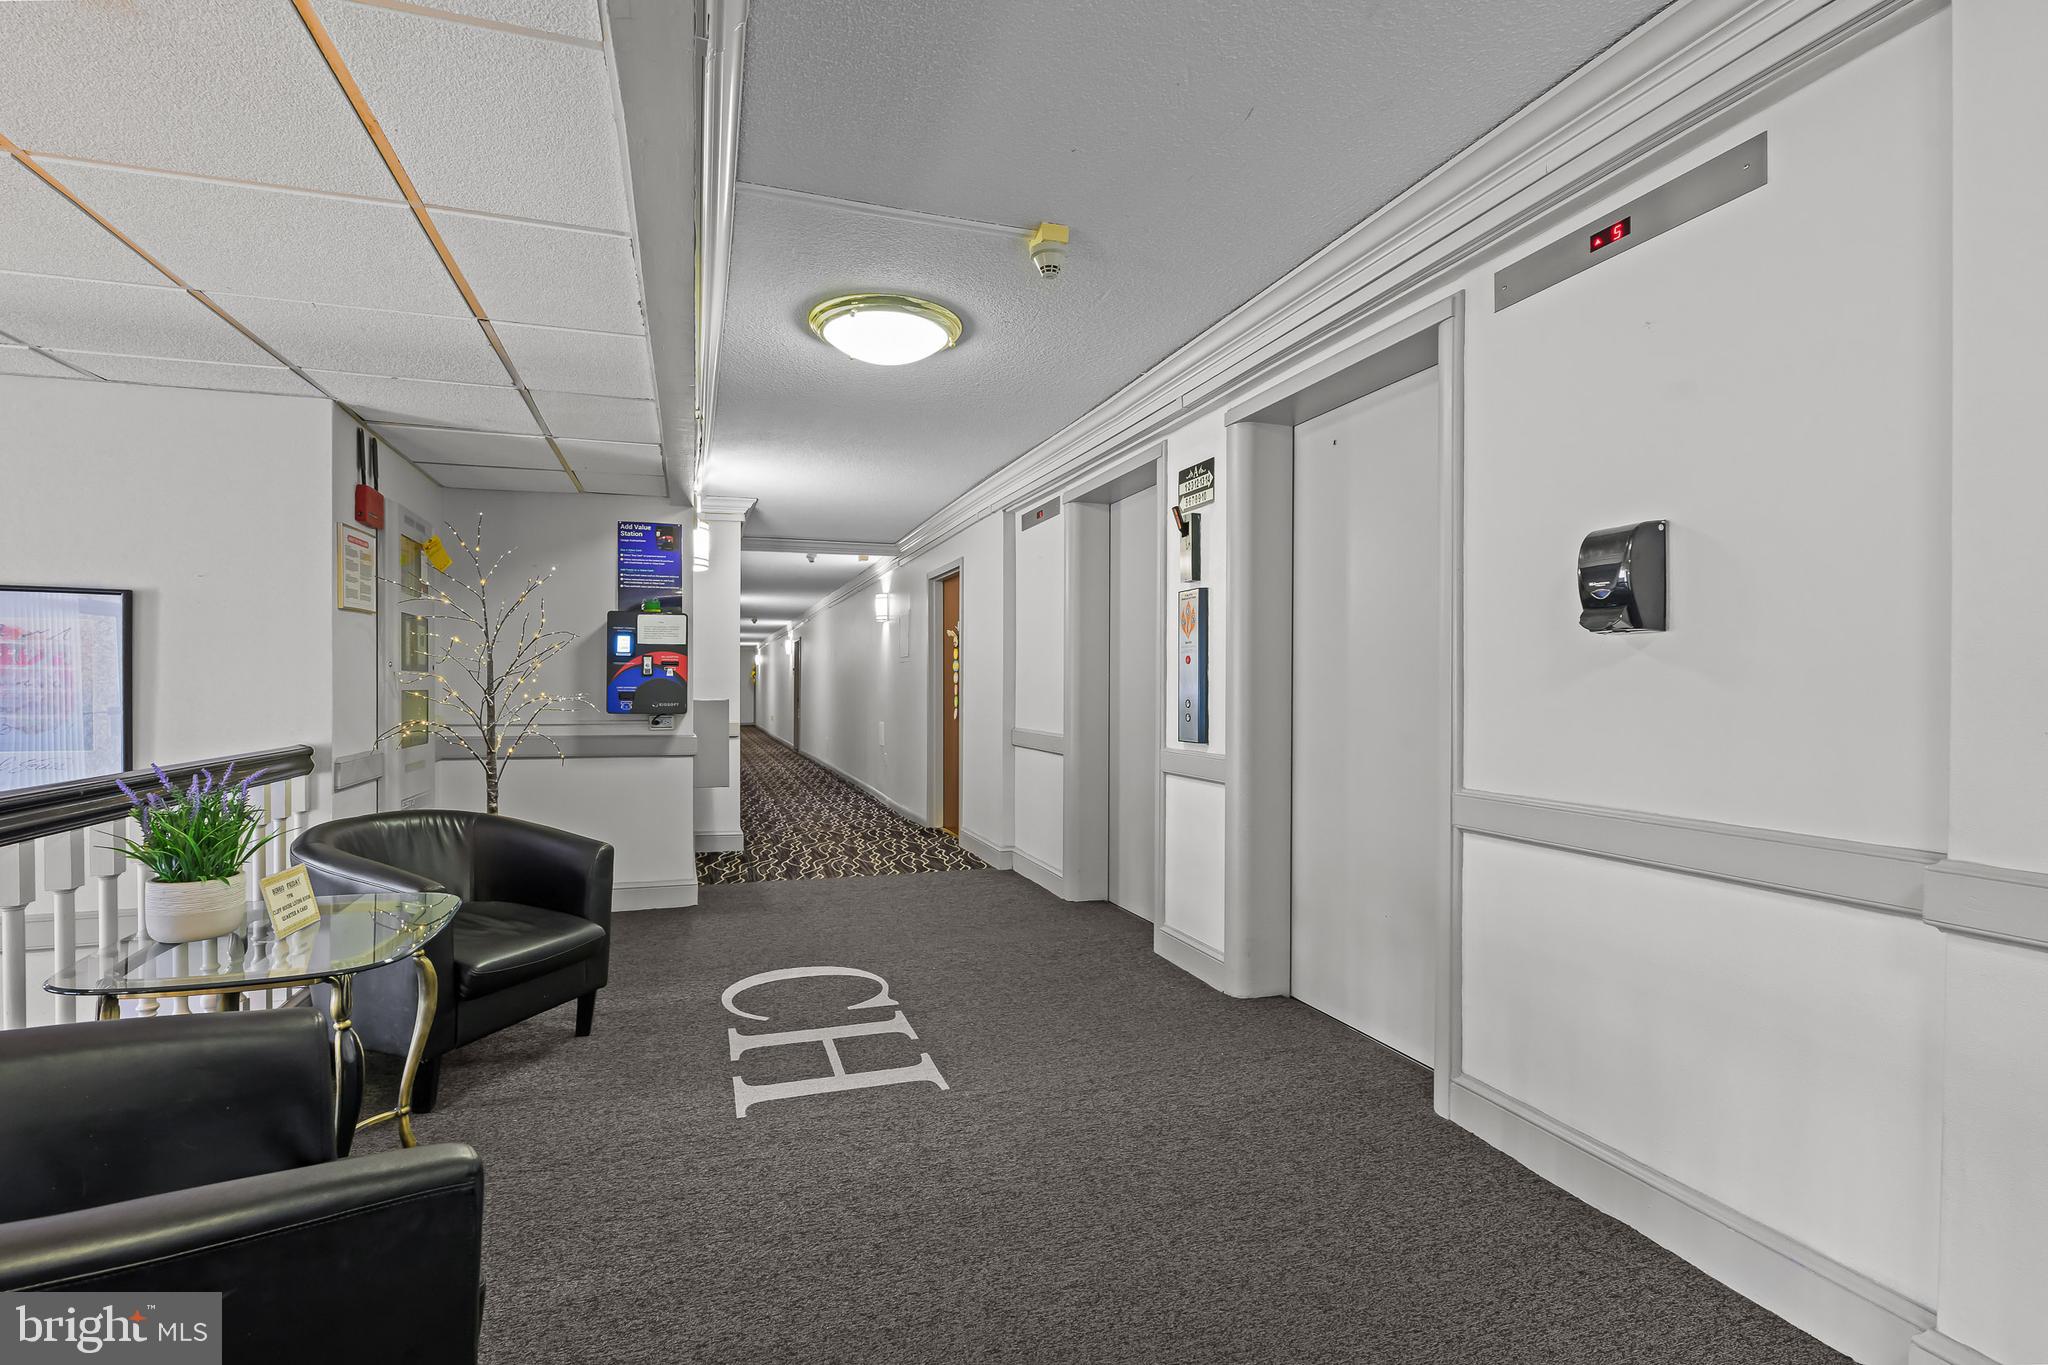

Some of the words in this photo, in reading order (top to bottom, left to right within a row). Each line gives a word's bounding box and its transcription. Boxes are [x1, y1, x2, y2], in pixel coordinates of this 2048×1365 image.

[1612, 223, 1623, 241] 5
[287, 879, 301, 889] FRIDAY
[721, 966, 950, 1118] CH
